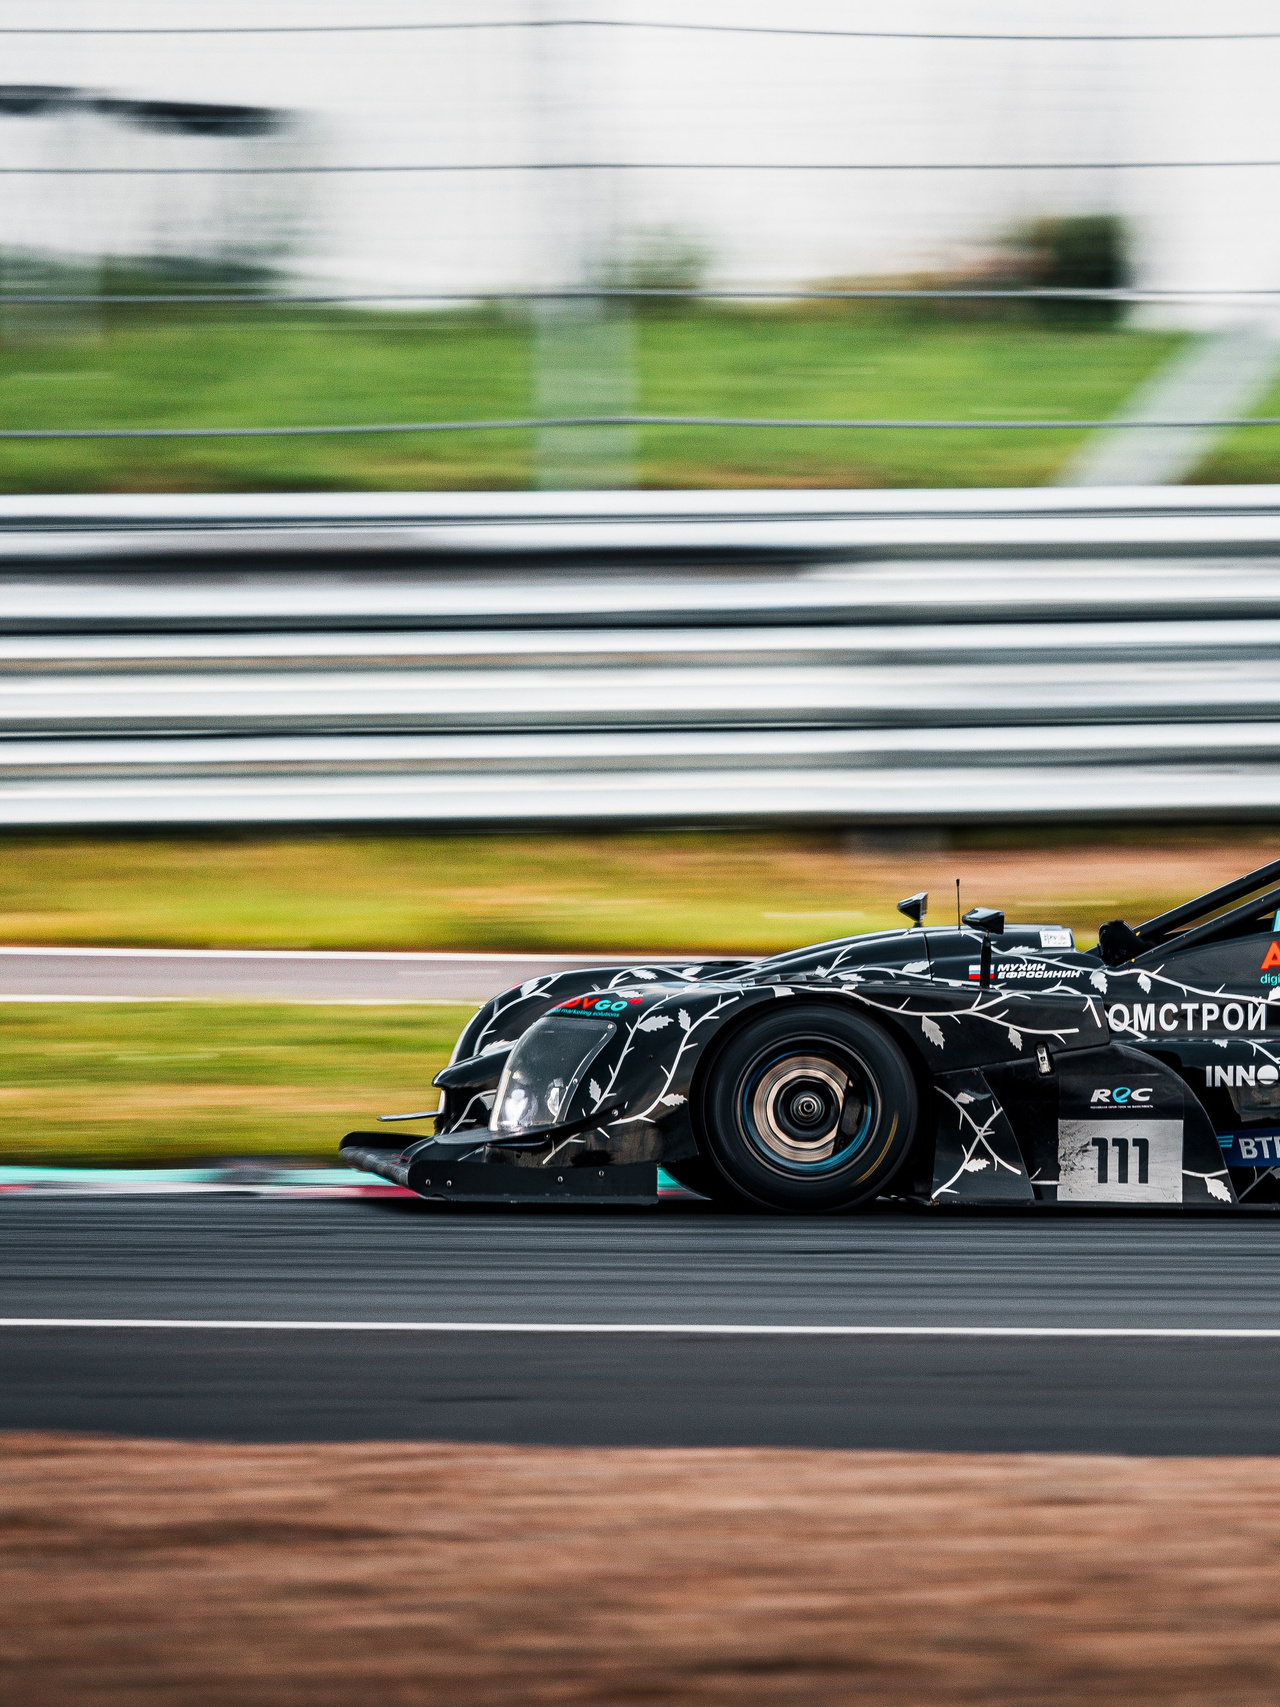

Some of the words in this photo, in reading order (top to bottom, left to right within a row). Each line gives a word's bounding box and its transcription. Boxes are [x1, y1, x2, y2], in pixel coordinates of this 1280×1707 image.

[997, 963, 1046, 971] МУХИН
[997, 970, 1080, 979] ЕФРОСИНИН
[554, 996, 628, 1011] DVGO
[592, 1010, 620, 1018] solutions
[1091, 1137, 1149, 1184] 111
